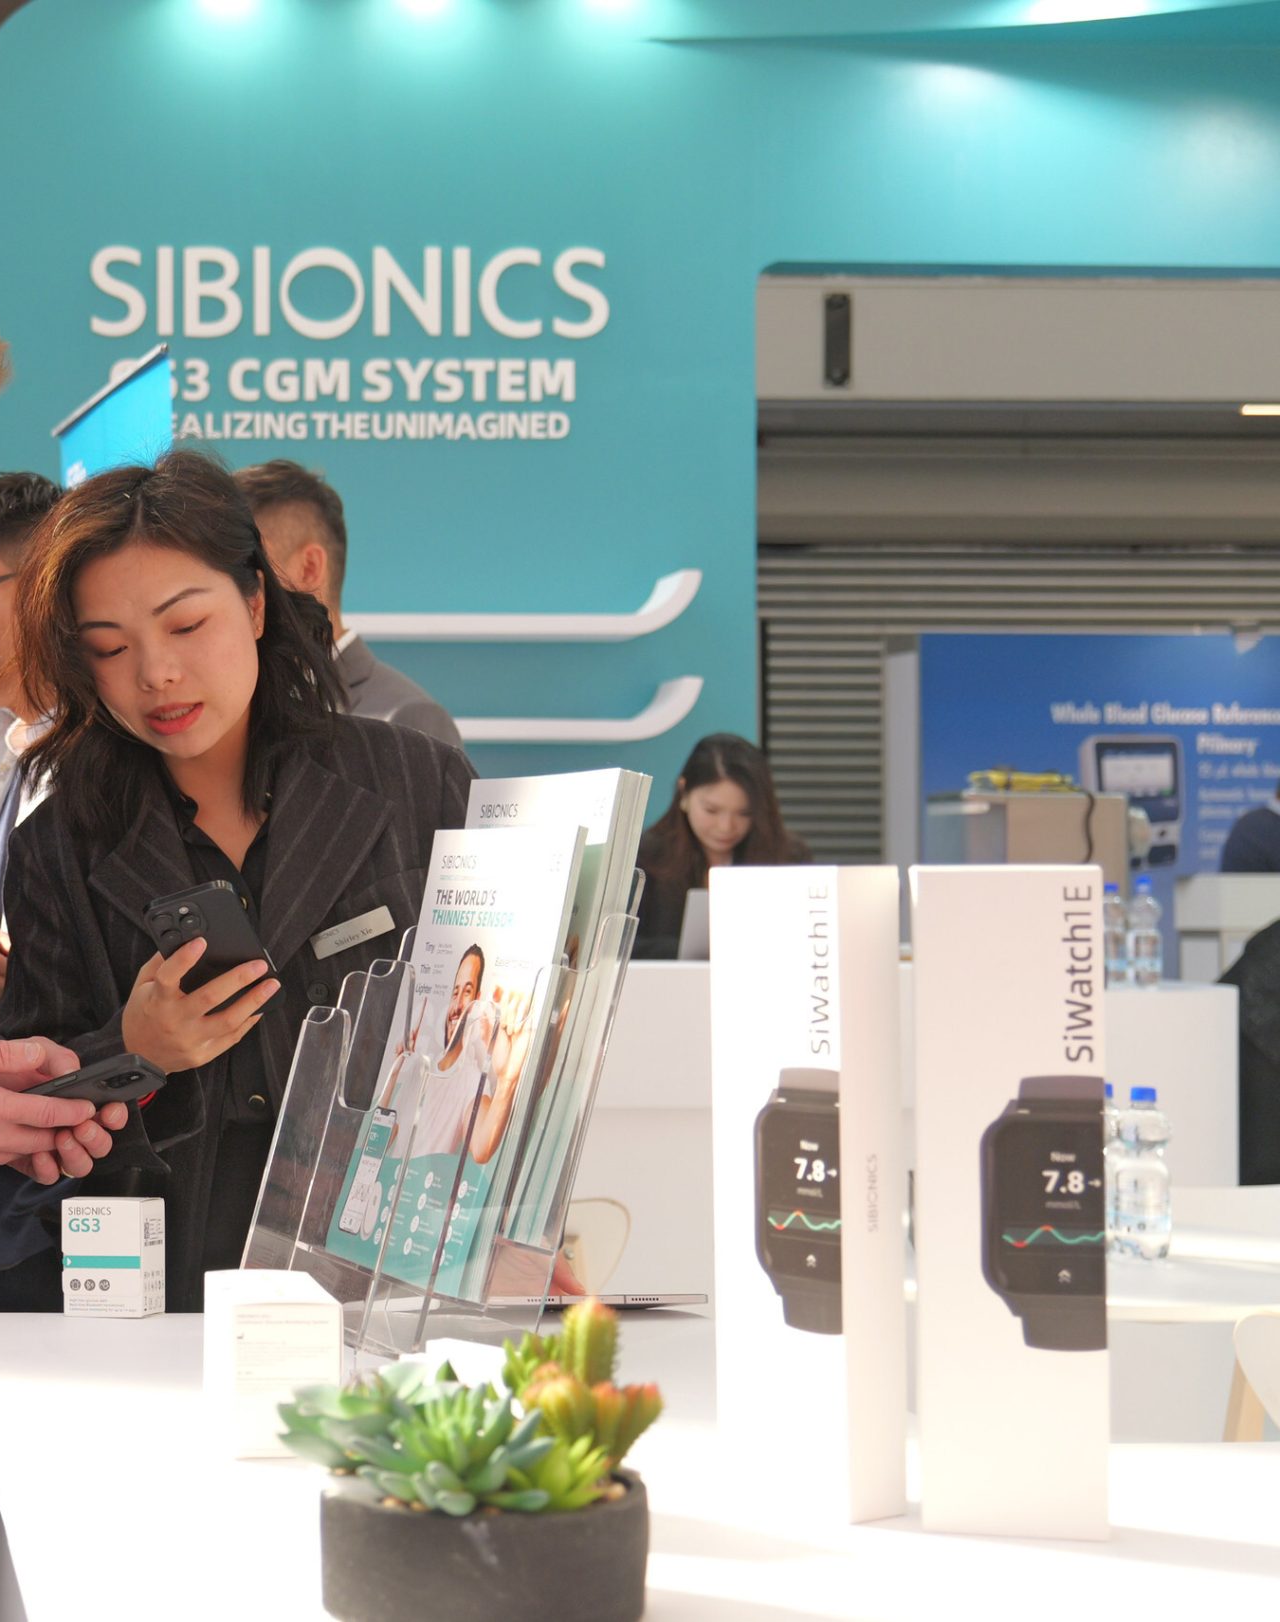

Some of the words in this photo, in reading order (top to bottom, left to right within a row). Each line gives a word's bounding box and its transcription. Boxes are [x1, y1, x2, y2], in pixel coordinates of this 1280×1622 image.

[90, 246, 610, 339] SIBIONICS
[229, 358, 350, 402] CGM
[362, 358, 576, 402] SYSTEM
[1051, 701, 1101, 724] Whole
[1104, 700, 1148, 724] Blood
[1151, 700, 1208, 724] Glucose
[479, 803, 519, 819] SIBIONICS
[441, 855, 478, 870] SIBIONICS
[435, 889, 453, 905] THE
[431, 909, 477, 927] THINNEST
[476, 911, 515, 928] SENSOR
[1062, 885, 1093, 1063] SiWatch1E
[793, 1157, 825, 1182] 7.8
[866, 1153, 878, 1232] SIBIONICS
[1042, 1170, 1085, 1194] 7.8
[68, 1207, 111, 1216] SIBIONICS
[68, 1218, 101, 1232] GS3
